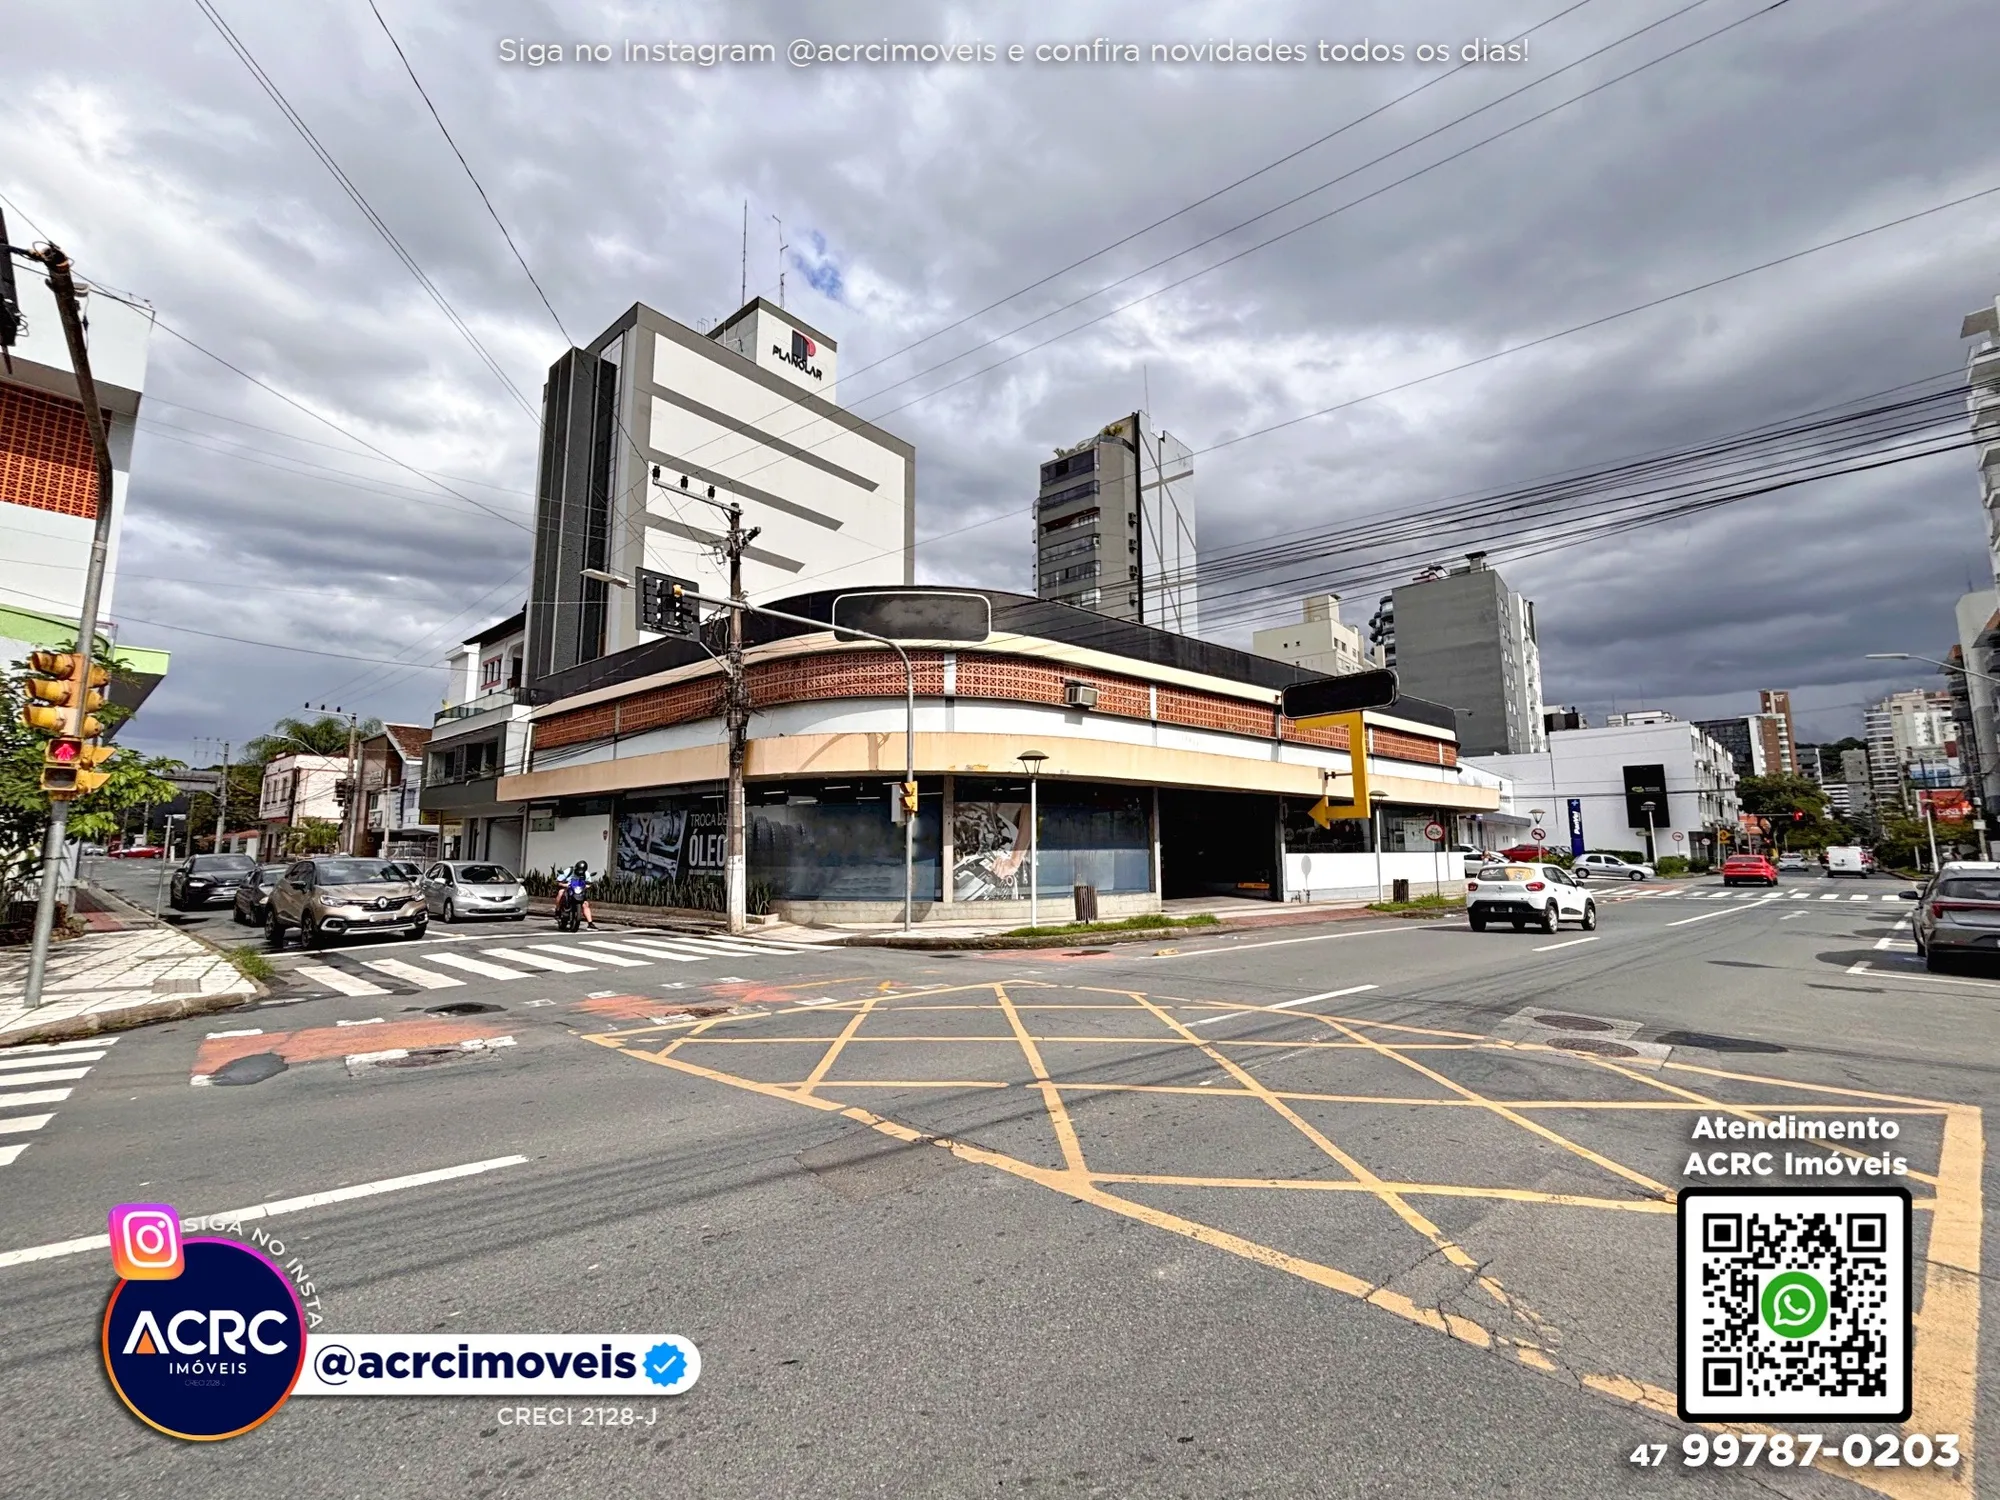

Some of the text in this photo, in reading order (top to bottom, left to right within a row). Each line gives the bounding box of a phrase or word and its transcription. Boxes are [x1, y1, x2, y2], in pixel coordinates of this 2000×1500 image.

[772, 344, 823, 381] PLANOLAR
[690, 812, 728, 827] TROCA DE
[689, 828, 728, 867] ÓLEO
